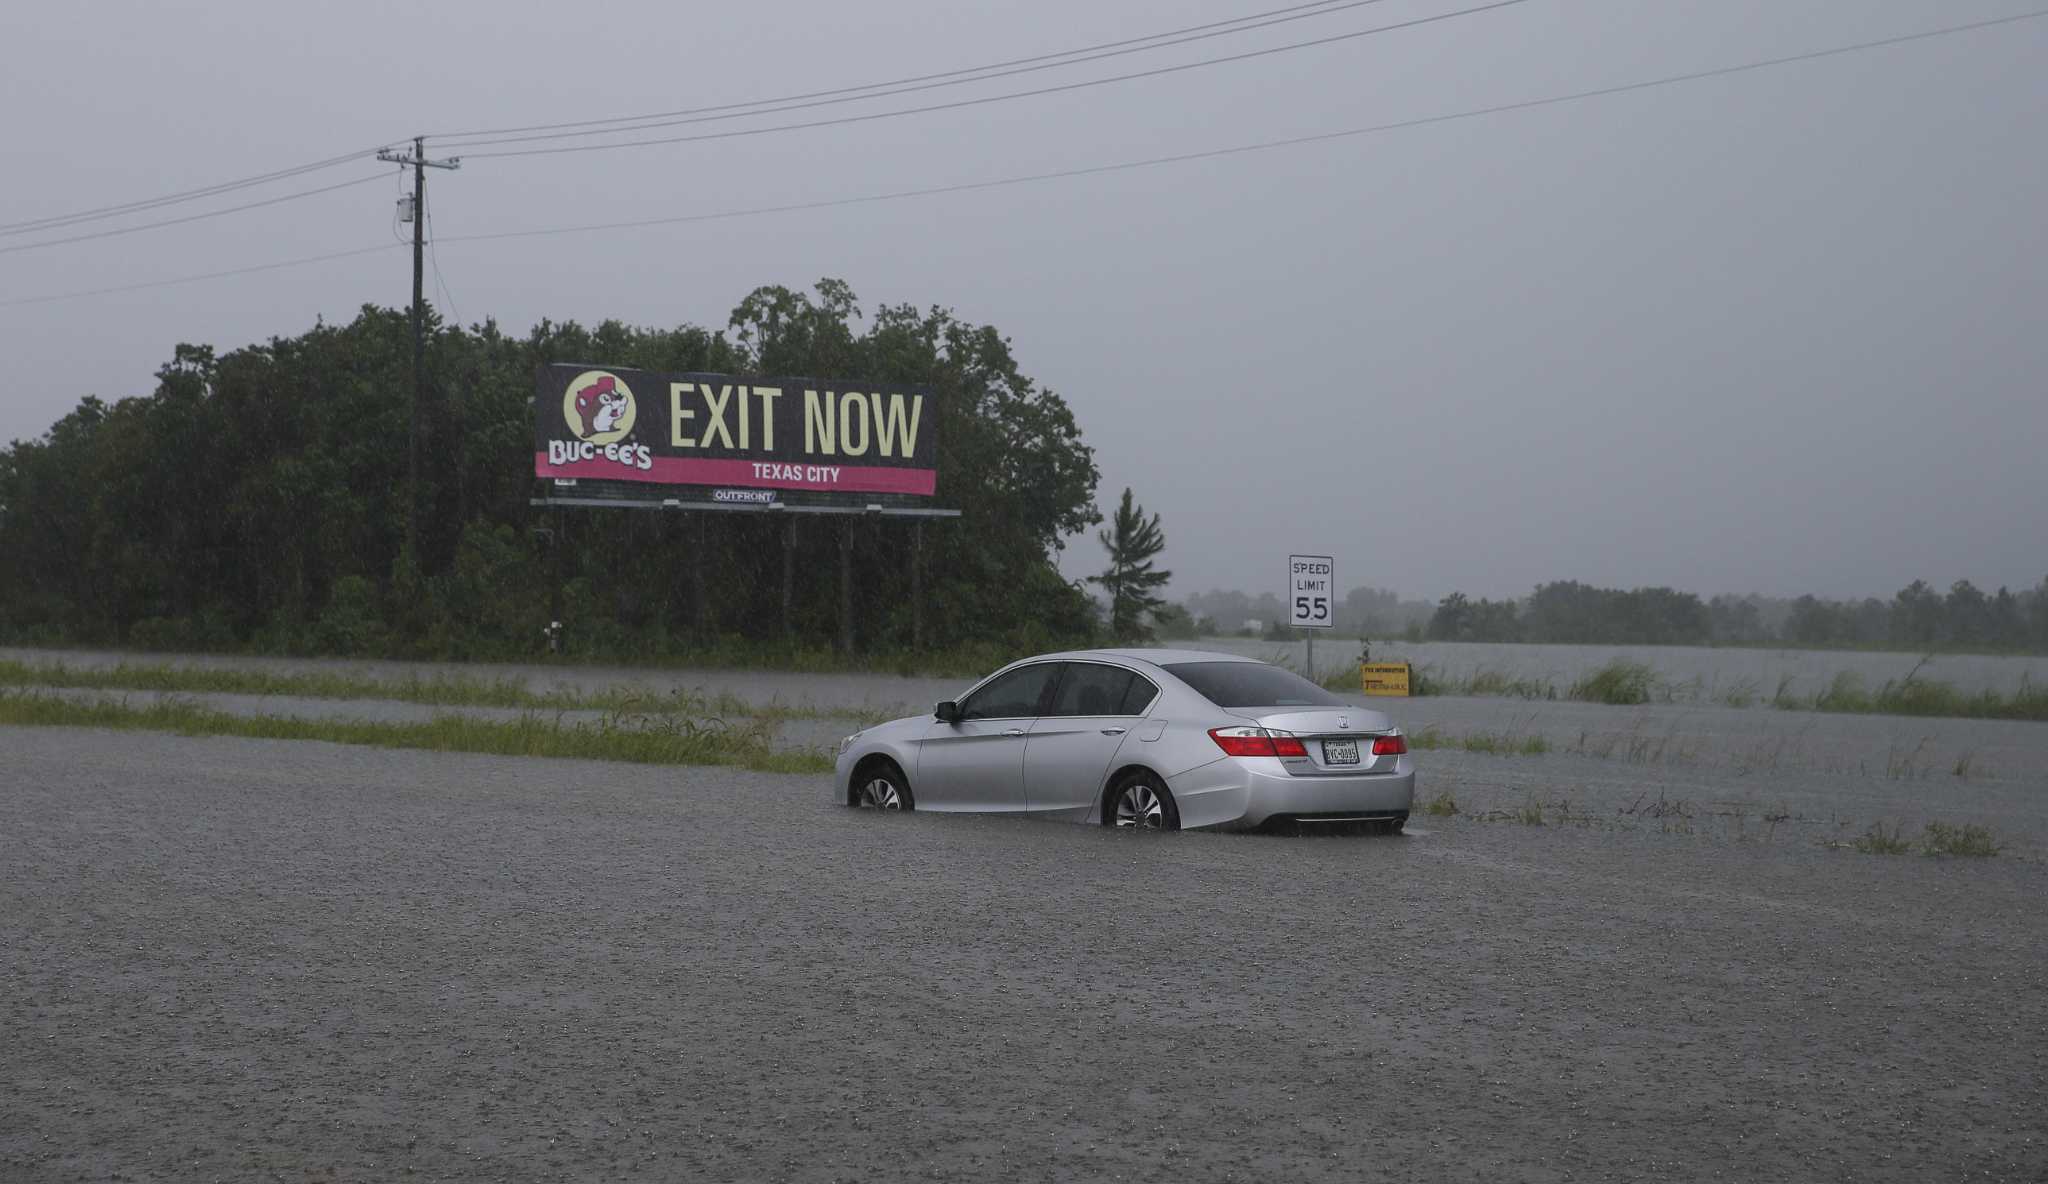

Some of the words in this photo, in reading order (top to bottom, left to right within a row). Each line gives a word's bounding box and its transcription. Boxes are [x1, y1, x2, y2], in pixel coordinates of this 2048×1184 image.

[670, 382, 782, 451] EXIT
[804, 390, 923, 458] NOW
[752, 463, 802, 481] TEXAS
[807, 464, 840, 483] CITY
[715, 490, 773, 502] OUTFRONT
[1293, 562, 1330, 575] SPEED
[1297, 580, 1325, 591] LIMIT
[1296, 596, 1328, 620] 55
